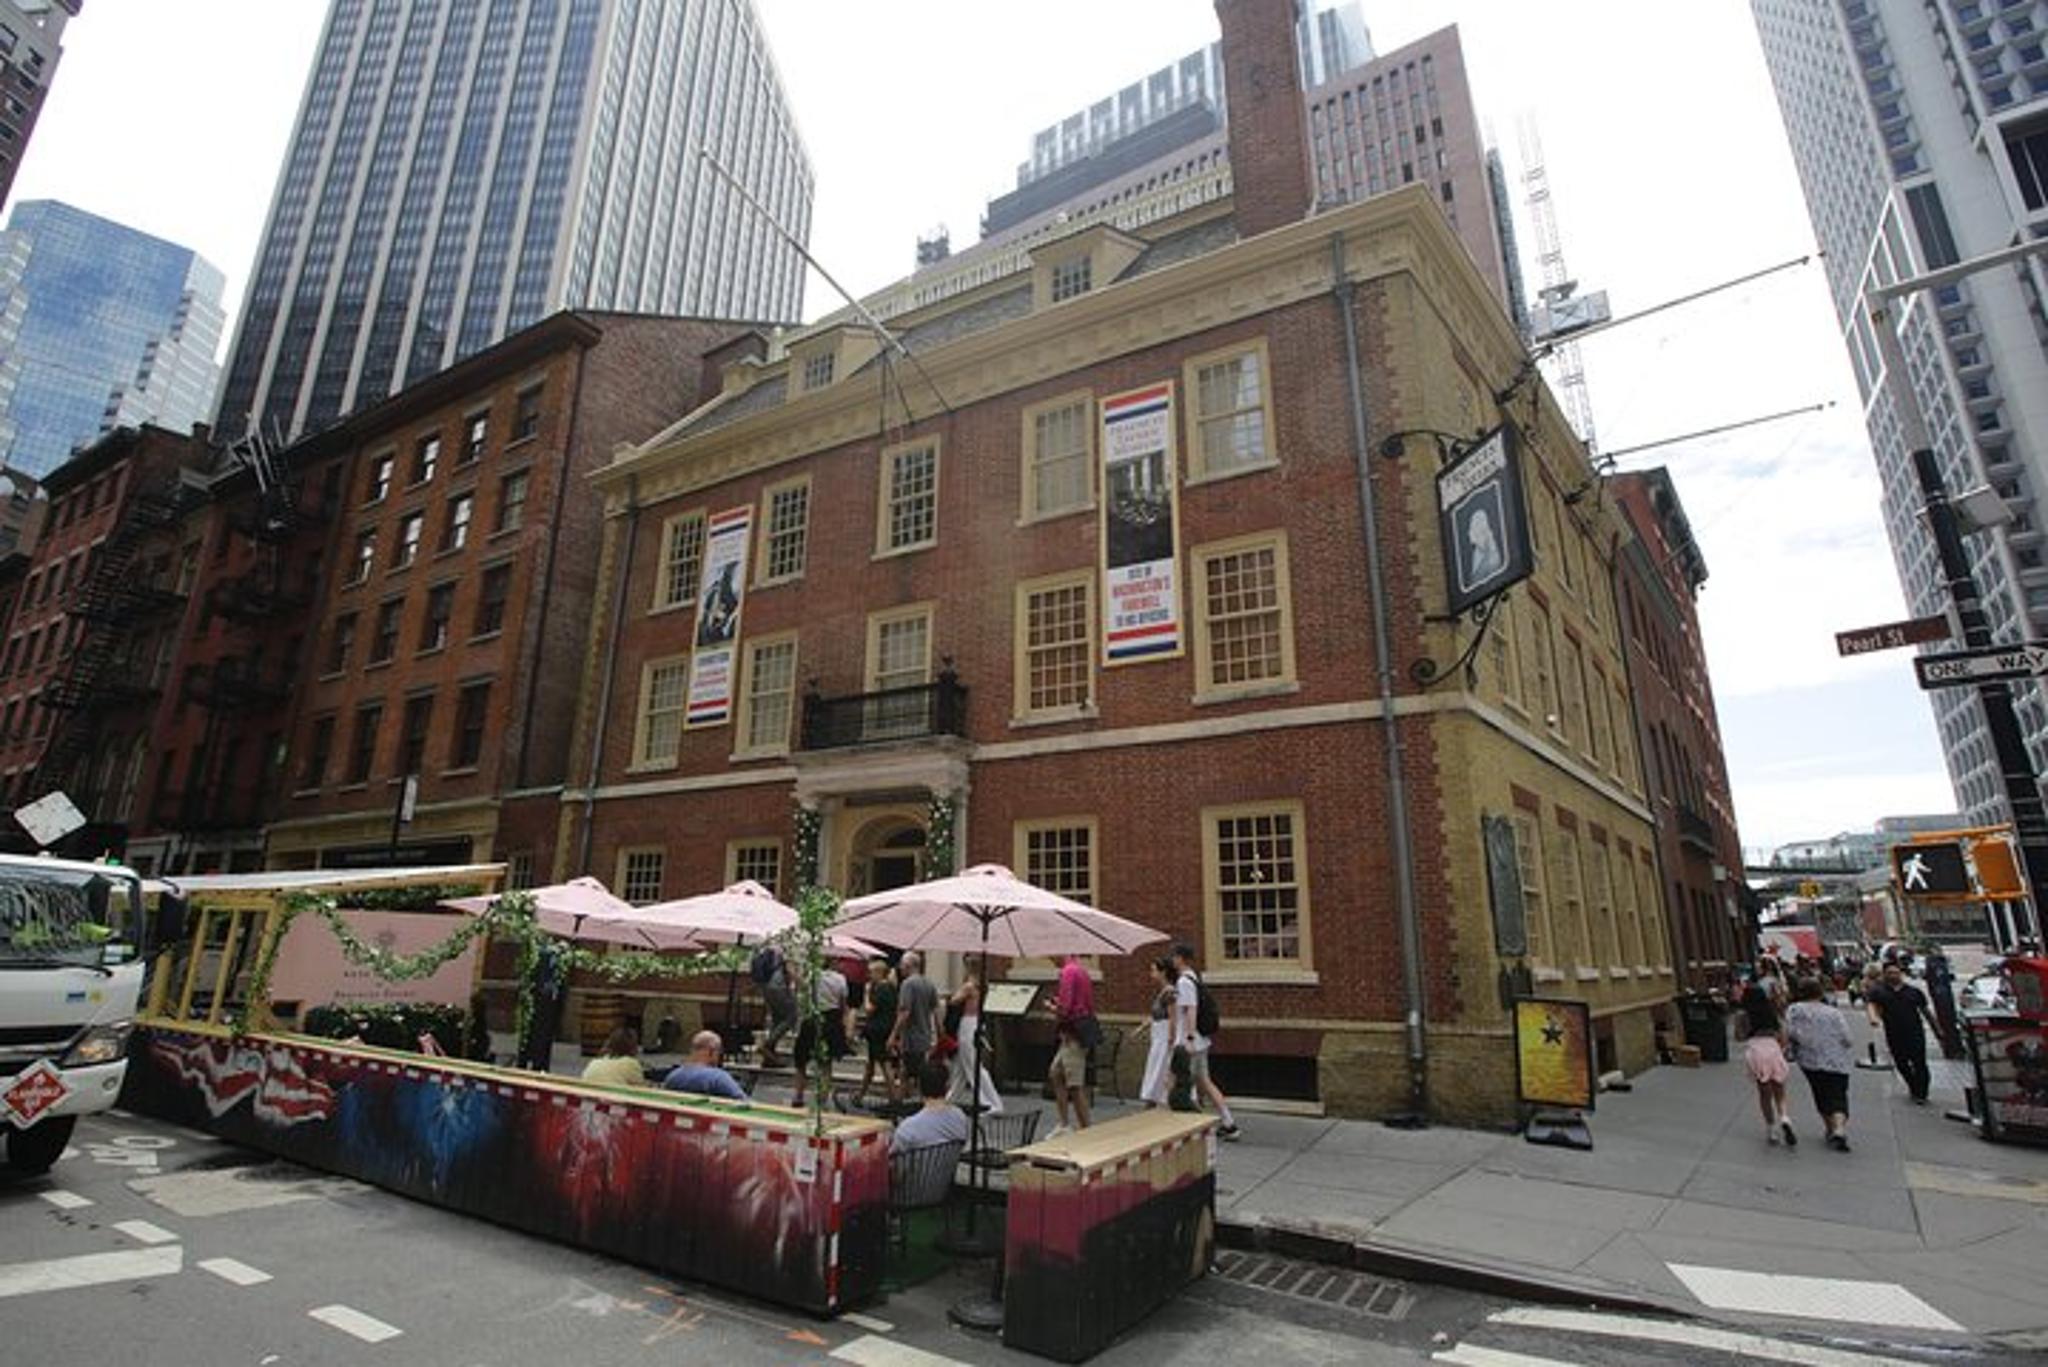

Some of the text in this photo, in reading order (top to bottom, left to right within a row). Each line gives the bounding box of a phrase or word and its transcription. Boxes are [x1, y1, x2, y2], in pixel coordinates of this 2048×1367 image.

[1841, 628, 1906, 653] Pearl St
[1928, 651, 2045, 678] ONE WAY
